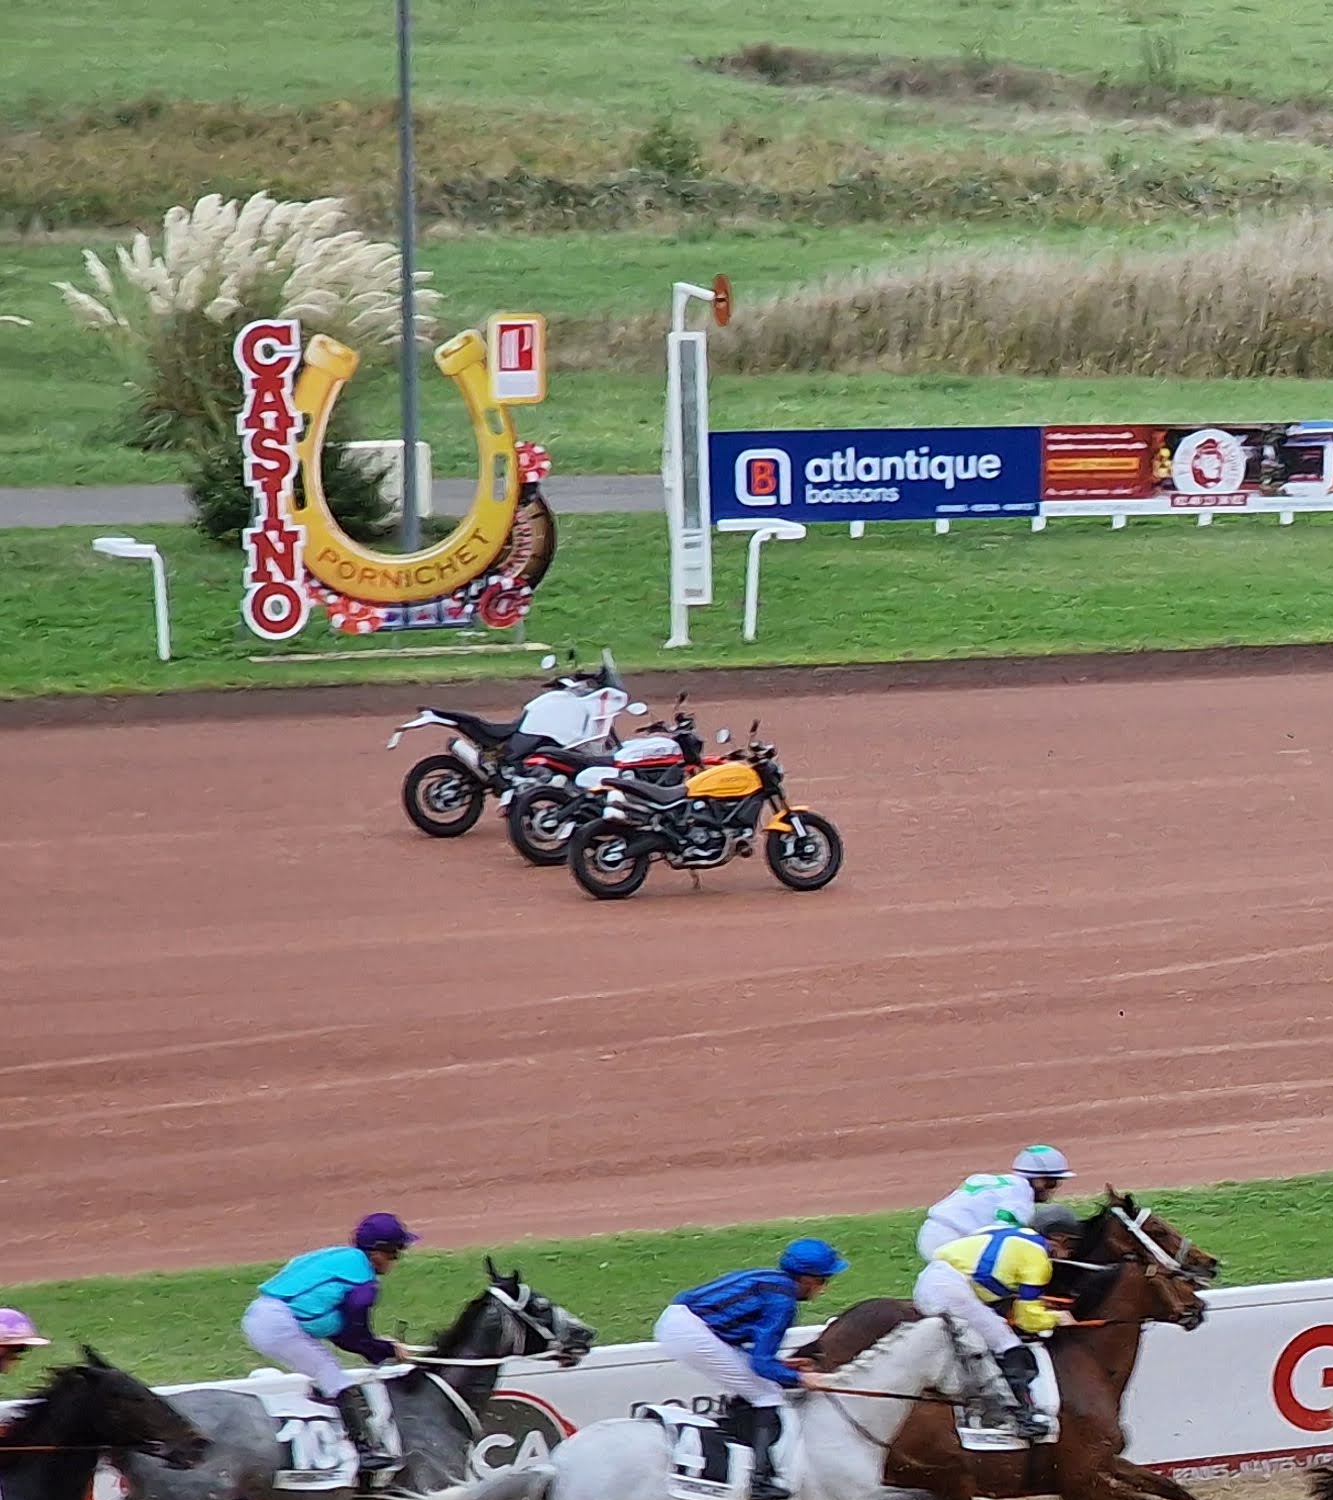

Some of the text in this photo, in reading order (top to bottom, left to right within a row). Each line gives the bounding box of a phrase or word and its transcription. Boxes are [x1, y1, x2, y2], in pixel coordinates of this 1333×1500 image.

[241, 324, 302, 634] CASINO
[804, 446, 1002, 490] atlantique
[316, 527, 491, 589] PORNICHET
